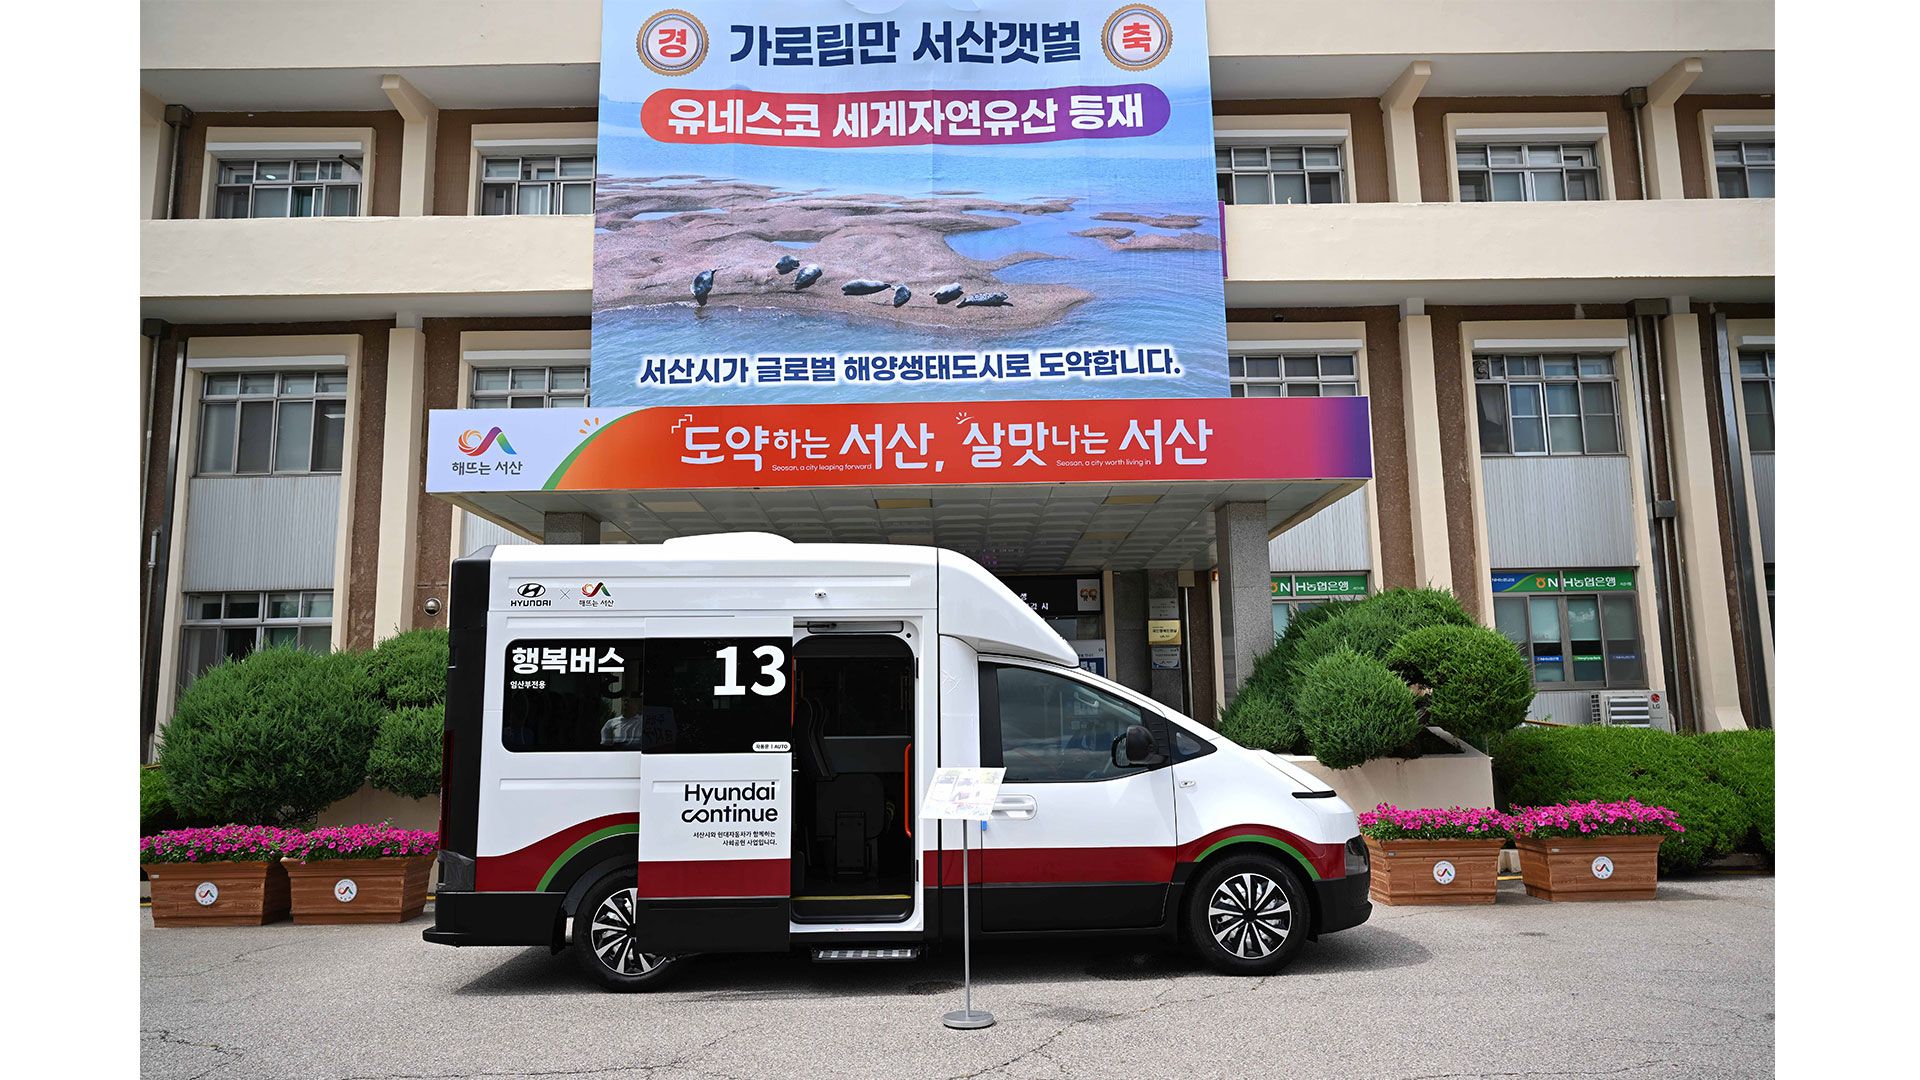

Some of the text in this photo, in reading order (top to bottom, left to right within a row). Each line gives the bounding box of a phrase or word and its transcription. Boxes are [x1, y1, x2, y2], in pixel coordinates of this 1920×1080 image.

[657, 27, 689, 58] 경
[730, 20, 1081, 67] 가로림만 서산갯벌
[1121, 22, 1153, 53] 축
[667, 92, 1144, 139] 유네스코 세계자연유산 등재
[640, 347, 1181, 385] 서산시가 글로벌 해양생태도시로 도약합니다.
[681, 418, 1214, 473] 도약하는 서산, 살맛나는 서산
[451, 460, 523, 477] 해뜨는 서산
[806, 463, 818, 472] city
[819, 463, 844, 472] leaping
[1091, 459, 1103, 467] city
[1104, 458, 1125, 467] worth
[1125, 457, 1144, 467] living
[510, 599, 552, 607] HYUNDAI
[578, 599, 615, 608] 해뜨는 서산
[511, 646, 625, 675] 행복버스
[713, 645, 787, 696] 13
[509, 680, 547, 690] 임산부전용
[684, 781, 775, 805] Hyundai
[681, 803, 778, 823] continue
